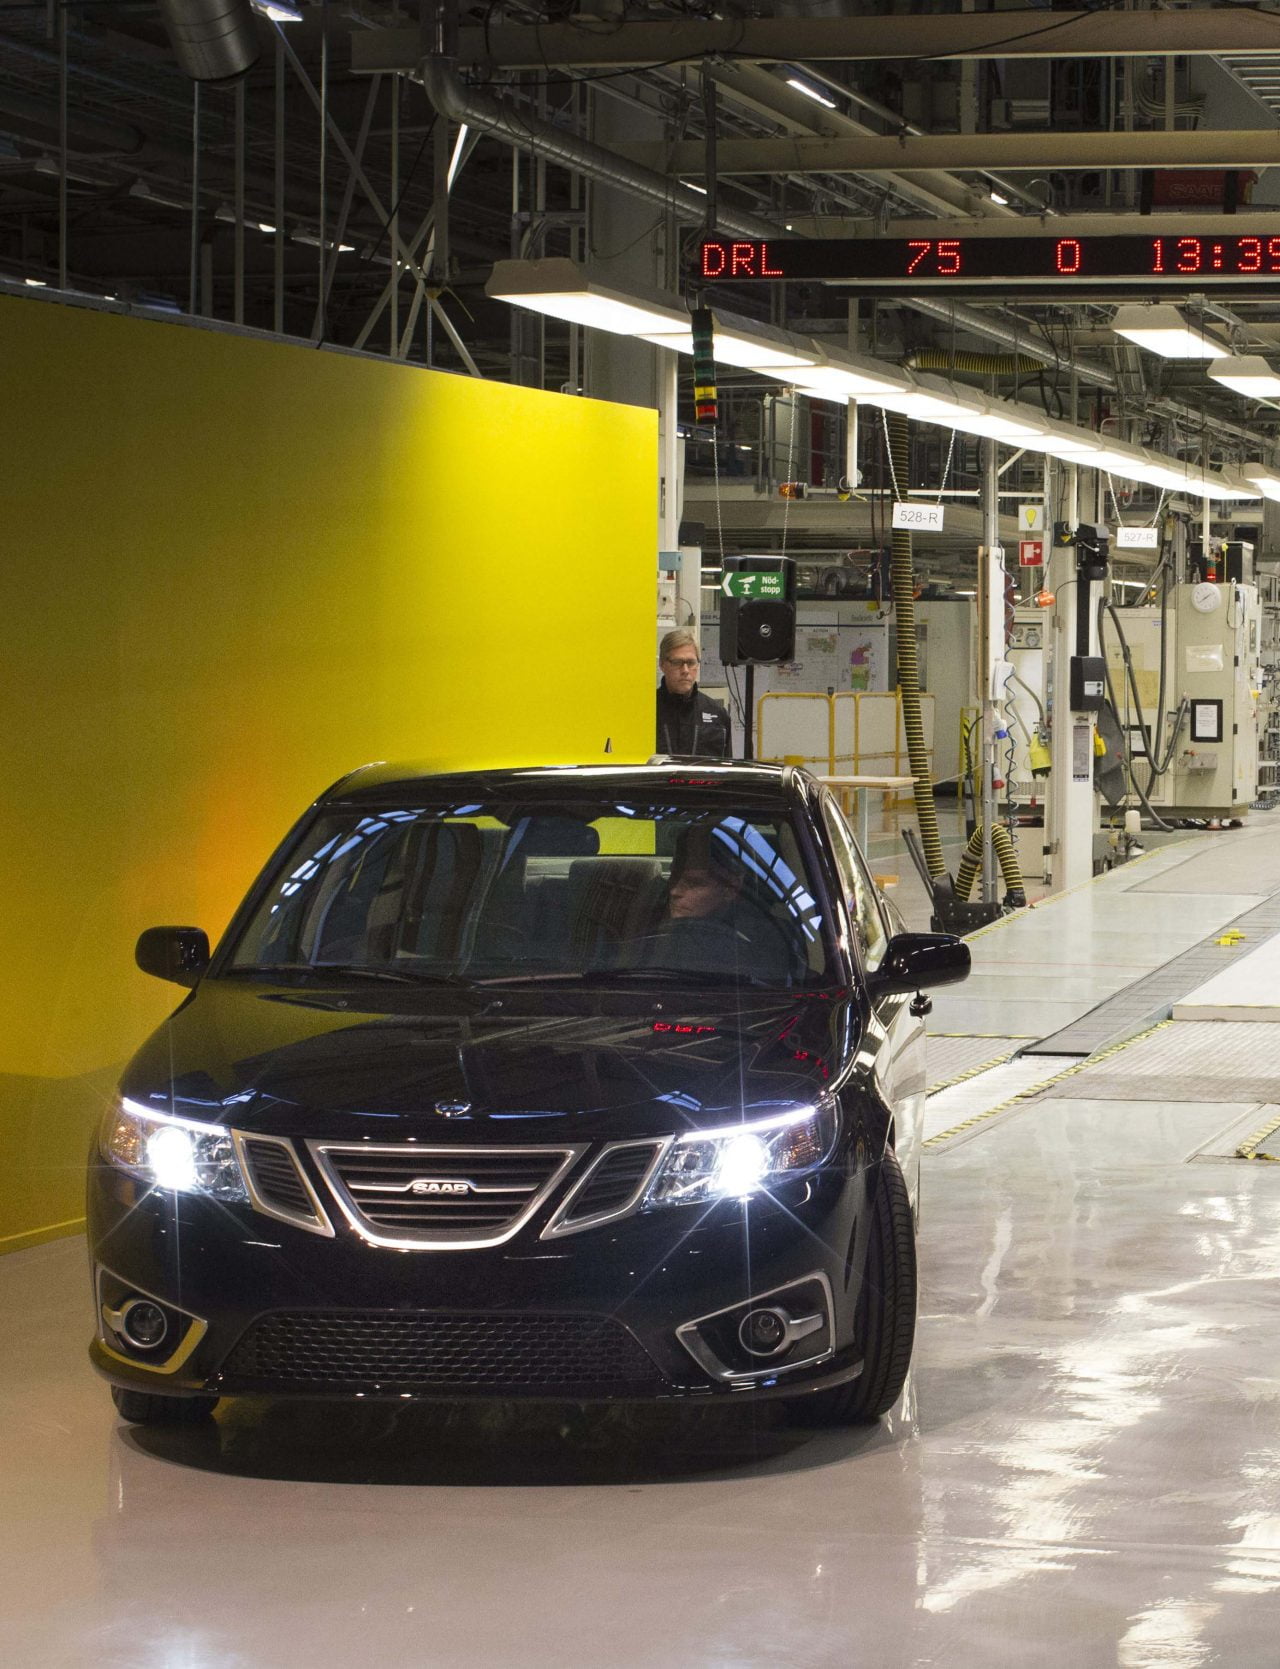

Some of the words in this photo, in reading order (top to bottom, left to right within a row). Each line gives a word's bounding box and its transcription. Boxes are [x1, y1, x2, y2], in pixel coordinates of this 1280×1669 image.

[704, 243, 783, 276] DRL
[908, 241, 961, 274] 75
[1057, 240, 1080, 273] 0
[900, 510, 938, 524] 528-R
[1124, 532, 1154, 543] 527-R
[761, 576, 779, 585] Nöd-
[760, 586, 781, 595] stopp
[413, 1183, 469, 1195] SAAB
